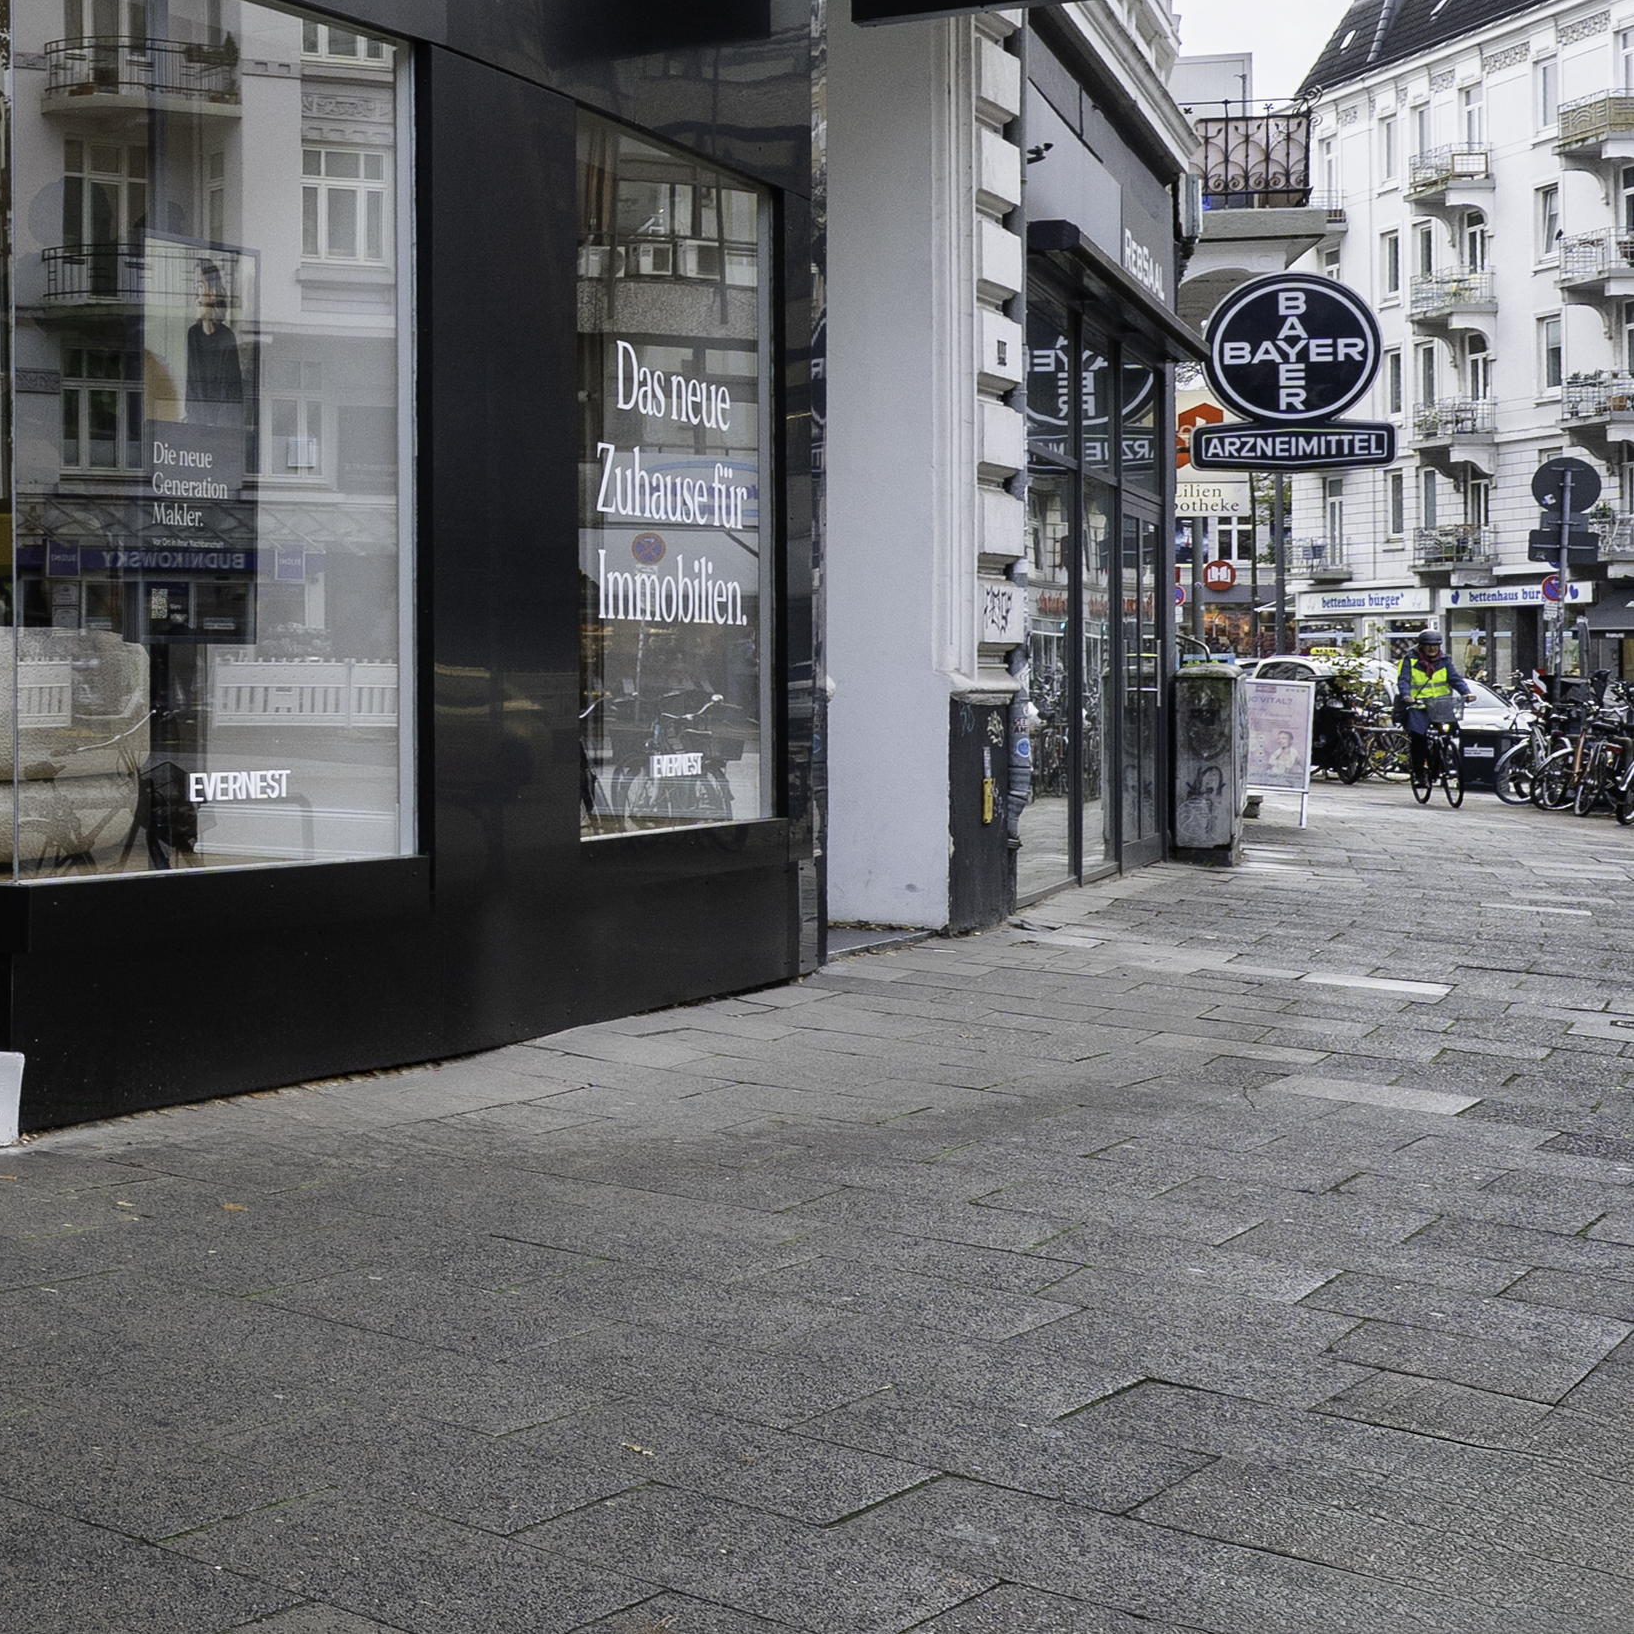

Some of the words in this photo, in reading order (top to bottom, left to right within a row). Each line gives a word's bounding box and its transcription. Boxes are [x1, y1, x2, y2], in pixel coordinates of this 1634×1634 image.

[1222, 336, 1366, 366] BAYER
[1277, 291, 1308, 411] BAYER
[615, 339, 667, 419] Das
[670, 369, 731, 432] neue
[152, 441, 177, 466] Die
[179, 449, 213, 469] neue
[1205, 434, 1384, 458] ARZNEIMITTEL
[151, 471, 228, 500] Generation
[596, 441, 710, 527] Zuhause
[711, 462, 748, 530] für
[151, 501, 205, 528] Makler.
[597, 548, 748, 626] Immobilien.
[1468, 590, 1519, 603] bettenhaus
[1321, 596, 1366, 609] bettenhaus
[189, 769, 292, 803] EVERNEST
